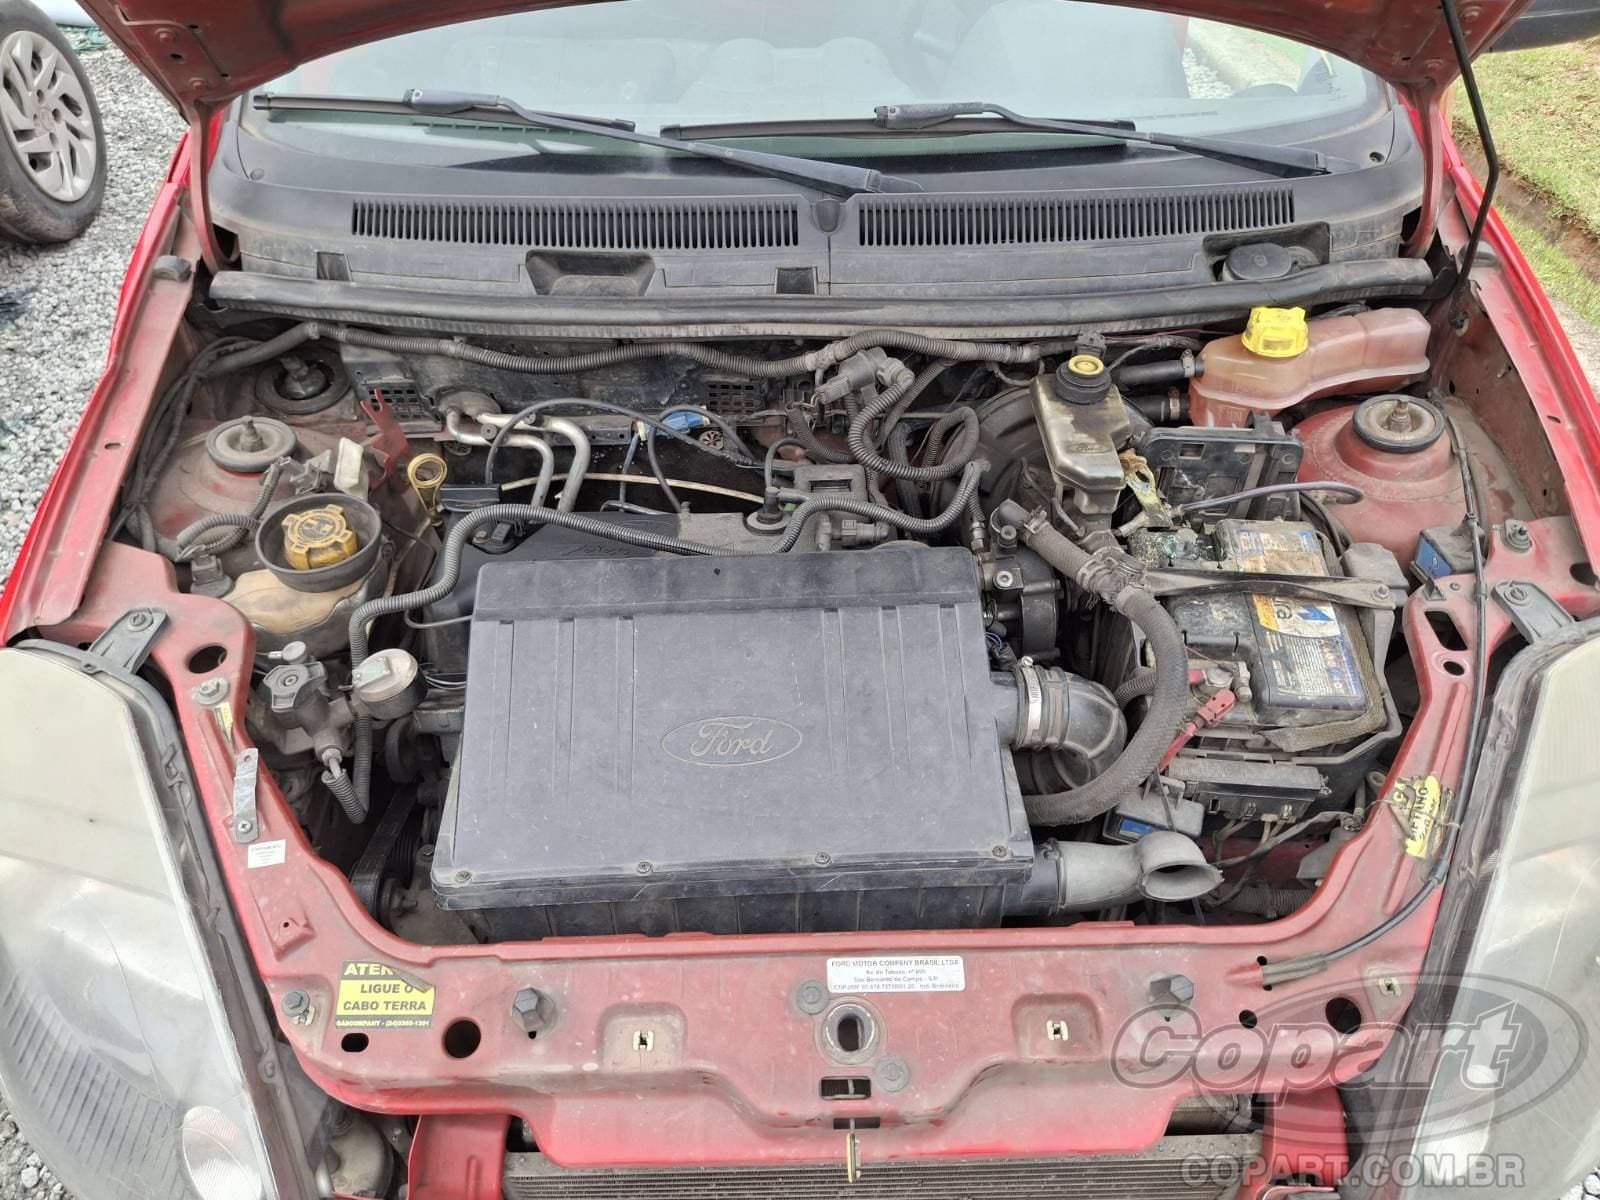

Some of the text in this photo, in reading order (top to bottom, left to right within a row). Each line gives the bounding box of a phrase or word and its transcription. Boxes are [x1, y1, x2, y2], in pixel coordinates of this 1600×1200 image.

[690, 721, 774, 757] Ford
[879, 959, 912, 967] COMPANY
[360, 983, 413, 994] LIGUE O
[343, 1001, 426, 1011] CABO TERRA
